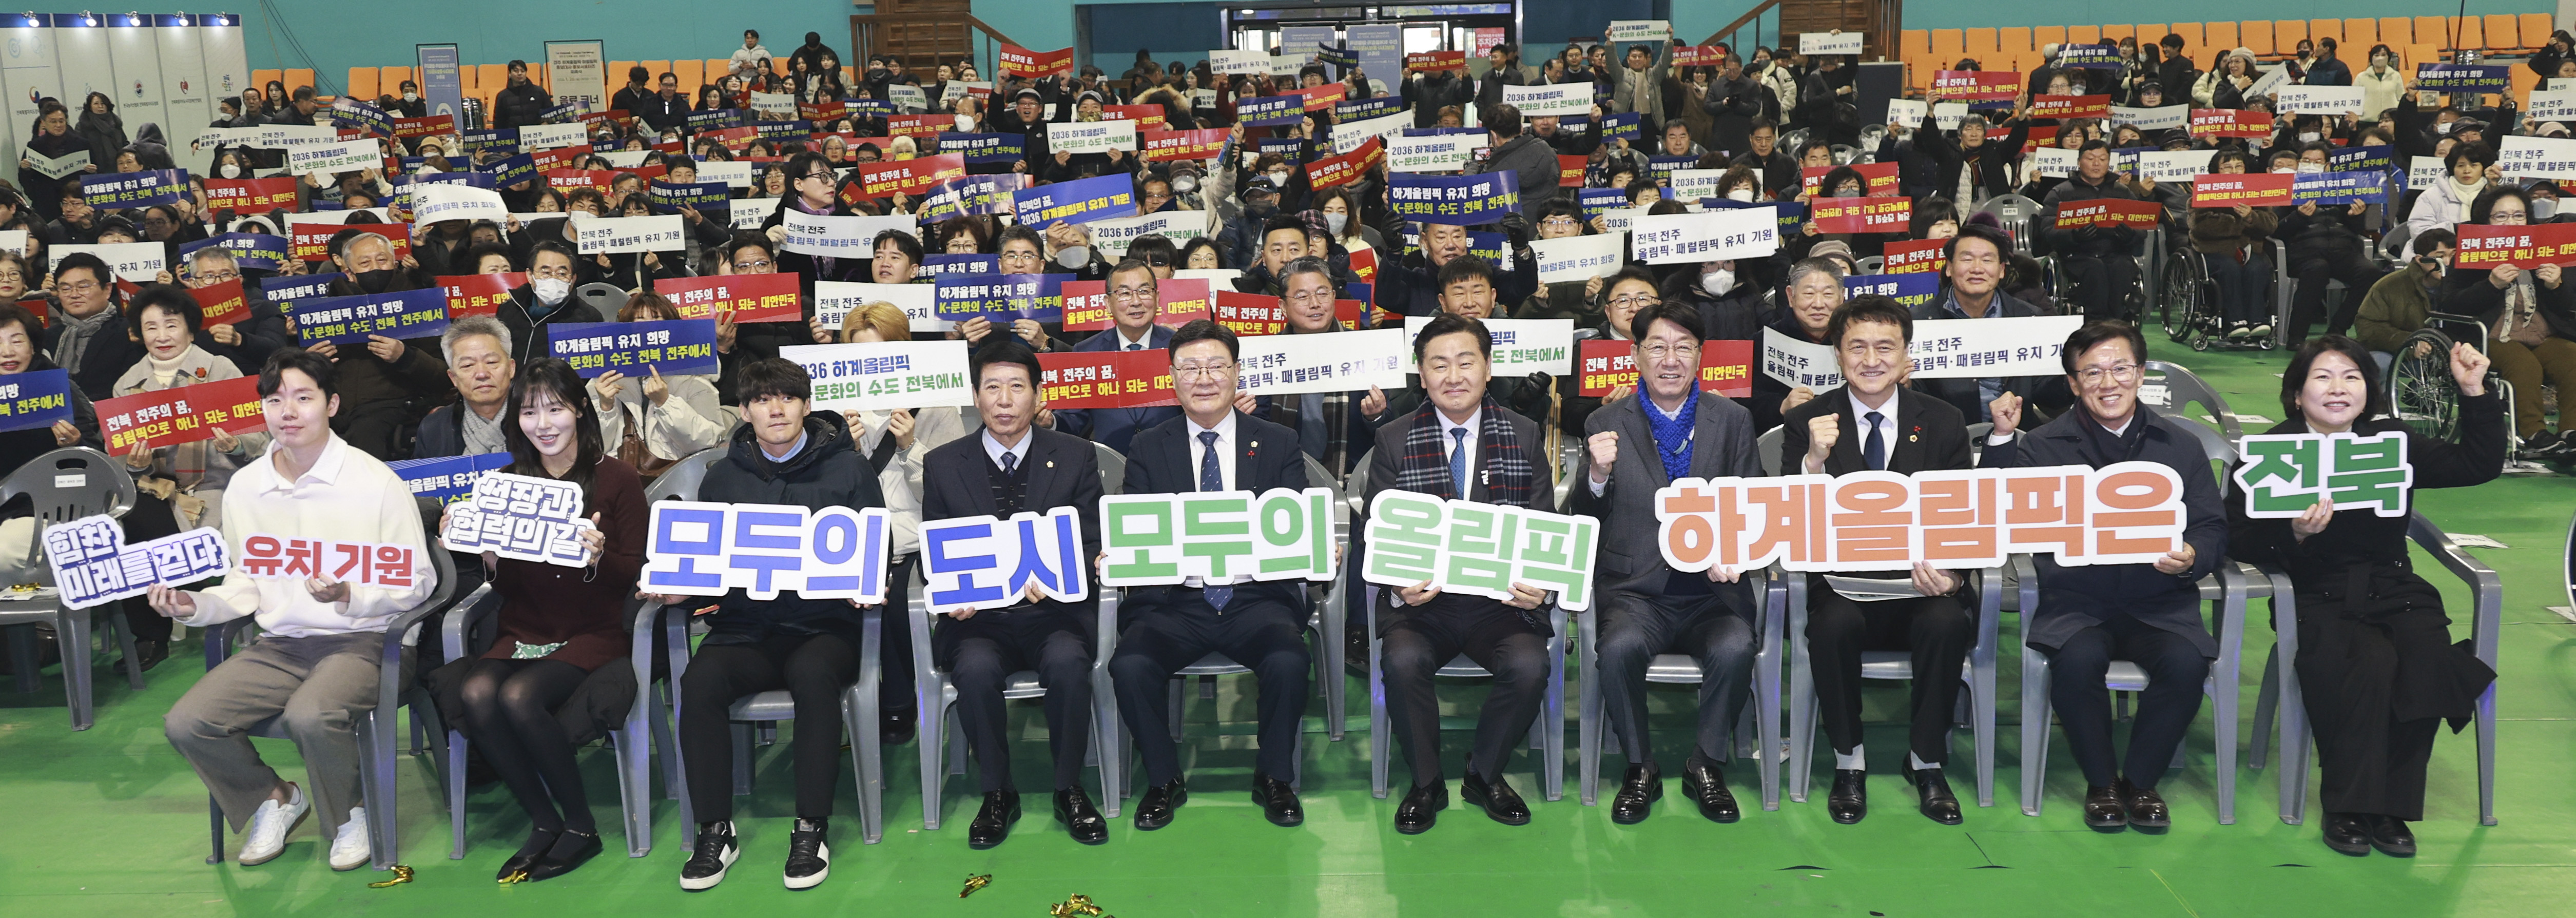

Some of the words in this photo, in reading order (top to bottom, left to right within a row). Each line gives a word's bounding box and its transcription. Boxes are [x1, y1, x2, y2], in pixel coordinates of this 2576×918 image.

[1996, 84, 2018, 92] 대한민국
[1052, 131, 1069, 139] 2036
[1072, 127, 1107, 138] 하계올림픽
[1052, 139, 1085, 149] K-문화의
[1105, 134, 1132, 145] 전북에서
[293, 152, 309, 161] 2036
[312, 148, 347, 158] 하계올림픽
[294, 159, 326, 170] K-문화의
[346, 154, 377, 164] 전북에서
[84, 181, 121, 194] 하계올림픽
[124, 180, 137, 190] 유치
[141, 177, 157, 187] 희망
[86, 194, 117, 205] K-문화의
[120, 191, 135, 202] 수도
[137, 188, 152, 199] 전북
[156, 184, 187, 196] 전주에서
[1392, 187, 1441, 200] 하계올림픽
[1446, 187, 1467, 199] 유치
[1471, 182, 1490, 198] 희망
[1018, 197, 1041, 213] 전북의
[1043, 196, 1054, 206] 꿈,
[1020, 214, 1040, 226] 2036
[1042, 202, 1086, 221] 하계올림픽
[1088, 198, 1109, 211] 유치
[1112, 193, 1130, 205] 기원
[1393, 203, 1433, 214] K-문화의
[1438, 204, 1458, 214] 수도
[1463, 202, 1483, 213] 전북
[1487, 192, 1518, 210] 전주에서
[1846, 206, 1860, 216] 되는
[1863, 205, 1875, 214] 하나
[2060, 209, 2074, 217] 전북
[2076, 206, 2097, 216] 전주의
[1815, 208, 1842, 218] 대한민국
[1875, 213, 1894, 224] 전주의
[1897, 212, 1910, 222] 전북
[2058, 216, 2091, 226] 올림픽으로
[2094, 213, 2107, 222] 하나
[2110, 213, 2125, 221] 되는
[580, 230, 595, 239] 전북
[597, 228, 613, 237] 전주
[788, 223, 805, 233] 전북
[807, 226, 826, 235] 전주
[1098, 228, 1121, 237] 2036
[1124, 219, 1167, 236] 하계올림픽
[1637, 232, 1657, 244] 전북
[1660, 229, 1681, 240] 전주
[582, 236, 640, 250] 올림픽·패럴림픽
[645, 234, 660, 242] 유치
[665, 230, 680, 241] 기원
[1638, 239, 1718, 261] 올림픽·패럴림픽
[1725, 233, 1745, 246] 유치
[1752, 229, 1772, 242] 기원
[2461, 238, 2481, 249] 전북
[2485, 237, 2515, 248] 전주의
[2520, 236, 2532, 247] 꿈,
[2459, 250, 2508, 264] 올림픽으로
[2514, 249, 2533, 259] 하나
[2537, 246, 2555, 257] 되는
[119, 263, 138, 273] 유치
[144, 260, 162, 270] 기원
[684, 290, 713, 304] 전주의
[718, 287, 730, 299] 꿈,
[940, 285, 988, 299] 하계올림픽
[993, 284, 1012, 297] 유치
[1016, 283, 1037, 295] 희망
[203, 297, 242, 318] 대한민국
[738, 299, 756, 309] 되는
[761, 294, 796, 308] 대한민국
[939, 300, 980, 314] K-문화의
[984, 299, 1003, 311] 수도
[1008, 298, 1028, 310] 전북
[300, 308, 352, 326] 하계올림픽
[356, 304, 378, 317] 유치
[382, 300, 403, 314] 희망
[302, 323, 345, 340] K-문화의
[350, 320, 371, 334] 수도
[375, 316, 397, 329] 전북
[402, 308, 443, 326] 전주에서
[555, 336, 613, 353] 하계올림픽
[618, 334, 641, 349] 유치
[647, 330, 670, 344] 희망
[1937, 337, 1962, 350] 전주
[610, 351, 632, 366] 수도
[638, 348, 661, 363] 전북
[666, 343, 711, 361] 전주에서
[1262, 352, 1286, 368] 전주
[1510, 347, 1565, 362] 전북에서
[1767, 346, 1785, 362] 전북
[1788, 354, 1809, 368] 전주
[1911, 349, 2008, 372] 올림픽·패럴림픽
[2017, 346, 2042, 361] 유치
[832, 355, 910, 377] 하계올림픽
[1063, 367, 1095, 382] 전주의
[1101, 365, 1116, 380] 꿈,
[1237, 362, 1332, 390] 올림픽·패럴림픽
[1340, 361, 1365, 374] 유치
[1373, 356, 1398, 371] 기원
[1585, 357, 1607, 372] 전북
[867, 378, 899, 396] 수도
[906, 373, 964, 392] 전북에서
[1584, 373, 1639, 389] 올림픽으로
[1702, 364, 1747, 381] 대한민국
[1097, 380, 1119, 396] 하나
[1126, 378, 1148, 393] 되는
[16, 393, 65, 415] 전주에서
[106, 413, 132, 432] 전북
[136, 403, 171, 423] 전주의
[176, 401, 191, 415] 꿈,
[111, 422, 171, 449] 올림픽으로
[175, 415, 198, 432] 하나
[205, 409, 227, 424] 되는
[2241, 435, 2407, 511] 전북
[478, 477, 576, 518] 성장과
[1664, 472, 2176, 563] 하계올림픽은
[449, 506, 548, 555] 협력의
[547, 517, 587, 558] 길
[1107, 496, 1326, 578] 모두의
[48, 523, 115, 566] 힘찬
[648, 508, 883, 597] 모두의
[1370, 497, 1592, 603] 올림픽
[60, 548, 159, 603] 미래를
[153, 534, 225, 577] 걷다
[244, 536, 320, 577] 유치
[334, 545, 412, 587] 기원
[925, 513, 1080, 606] 도시
